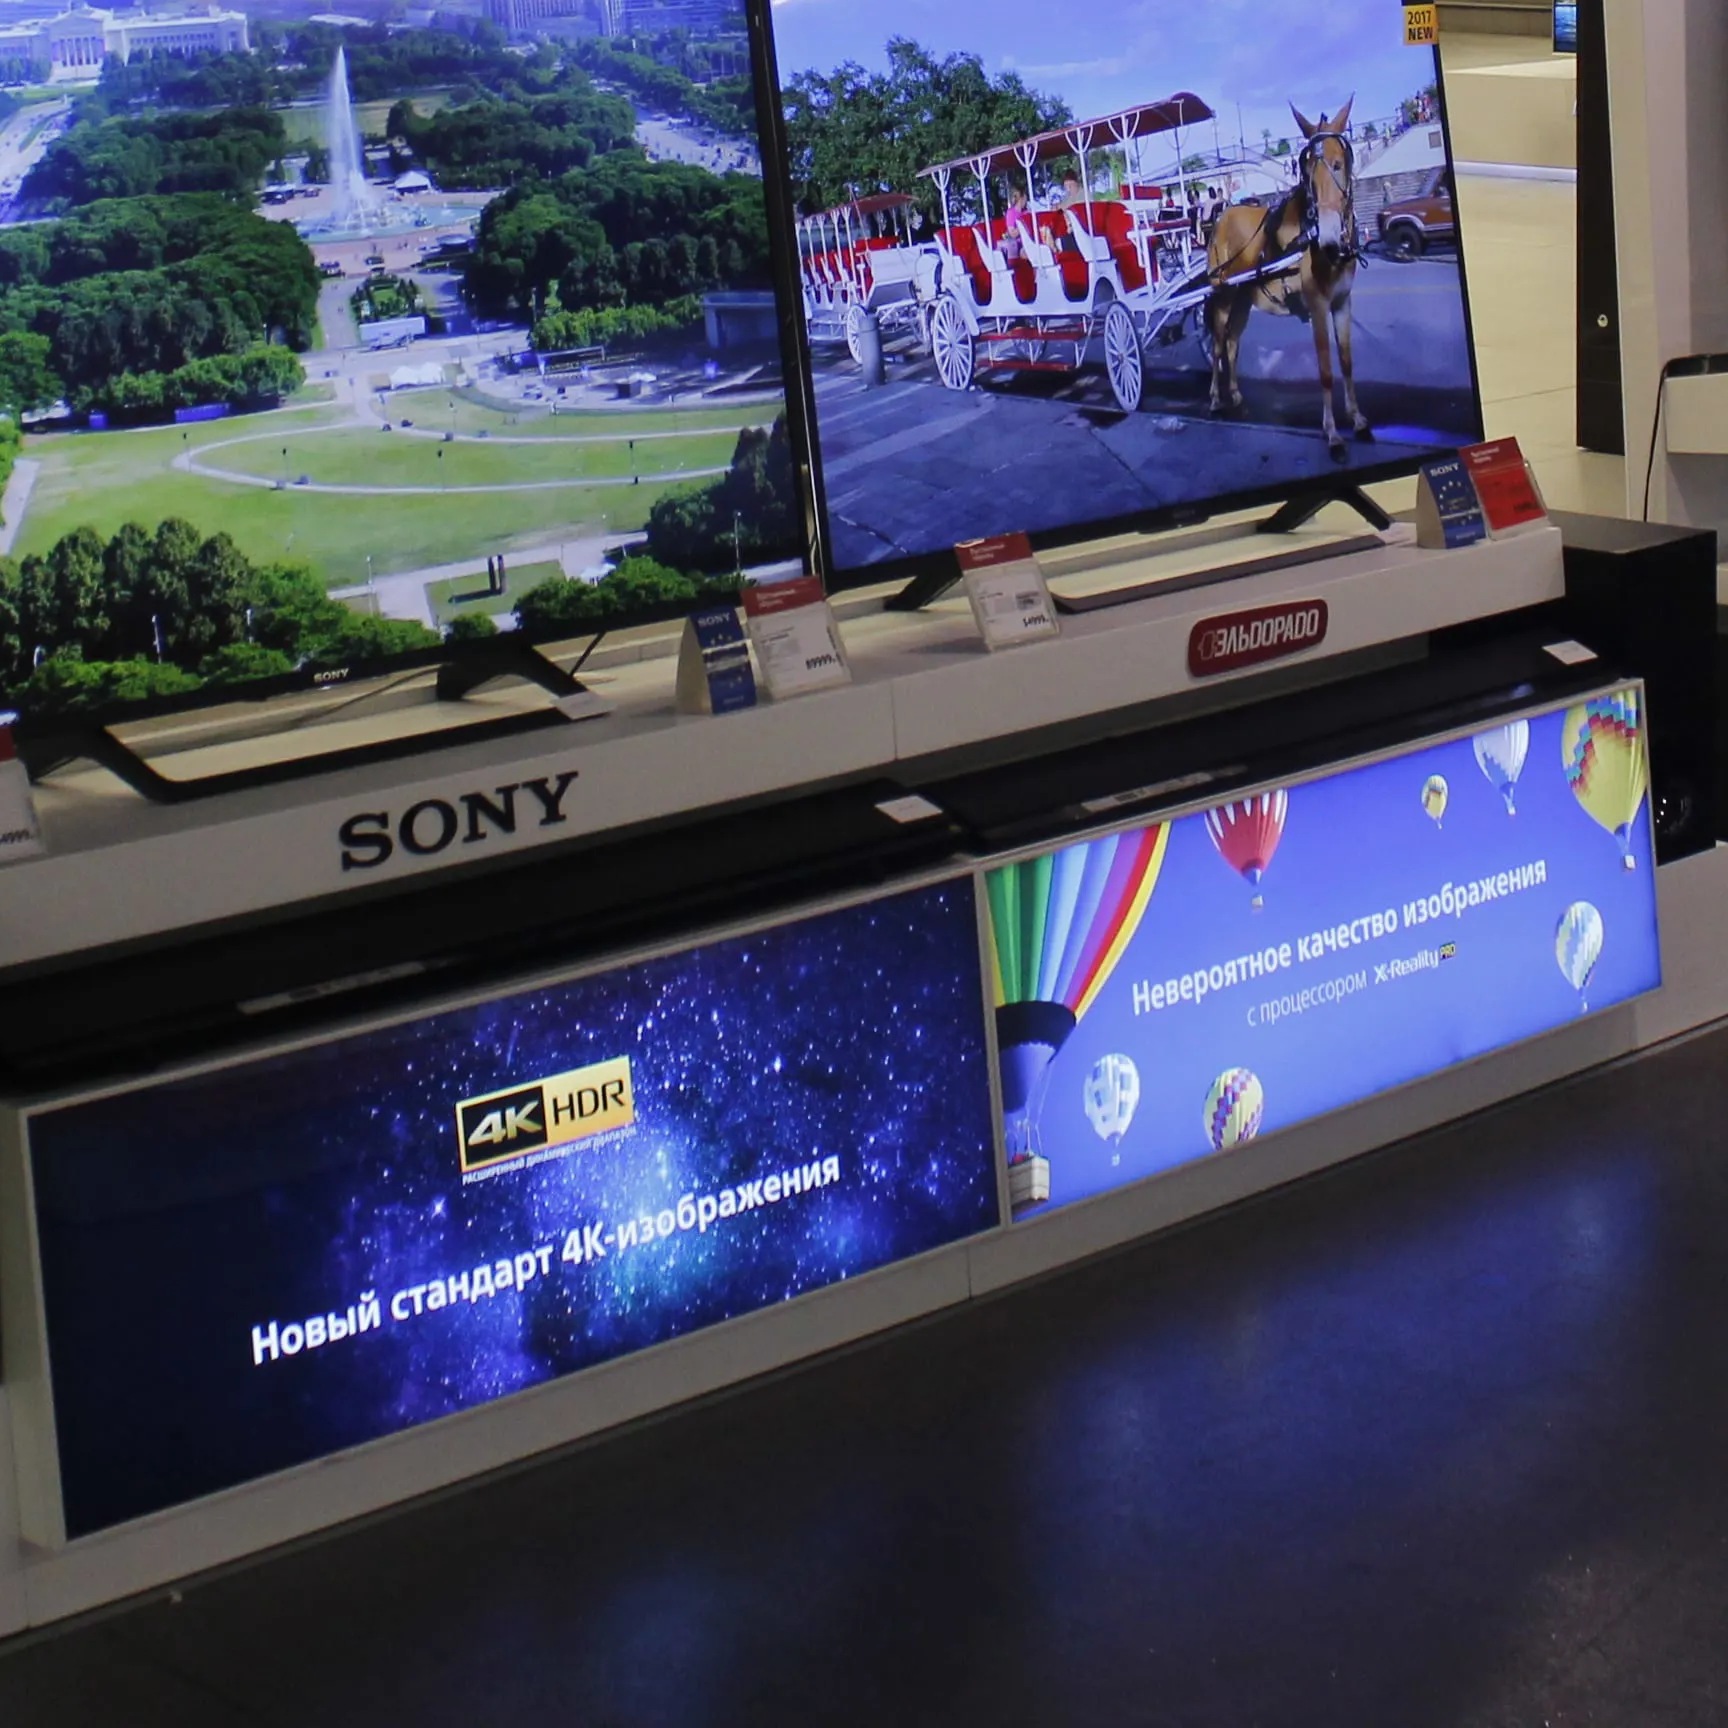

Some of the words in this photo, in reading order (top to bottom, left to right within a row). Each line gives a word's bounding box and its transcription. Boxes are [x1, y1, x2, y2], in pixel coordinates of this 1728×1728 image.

[1407, 10, 1432, 25] 2017
[1407, 26, 1434, 41] NEW
[1430, 462, 1460, 477] SONY
[697, 610, 732, 626] SONY
[314, 668, 349, 684] SONY
[338, 771, 579, 872] SONY
[1132, 941, 1292, 1017] Невероятное
[1296, 907, 1399, 962] качество
[1402, 858, 1548, 936] изображения
[1259, 968, 1369, 1028] процессором
[467, 1099, 543, 1147] 4K
[552, 1078, 626, 1125] HDR
[251, 1291, 381, 1366] Новый
[391, 1244, 554, 1321] стандарт
